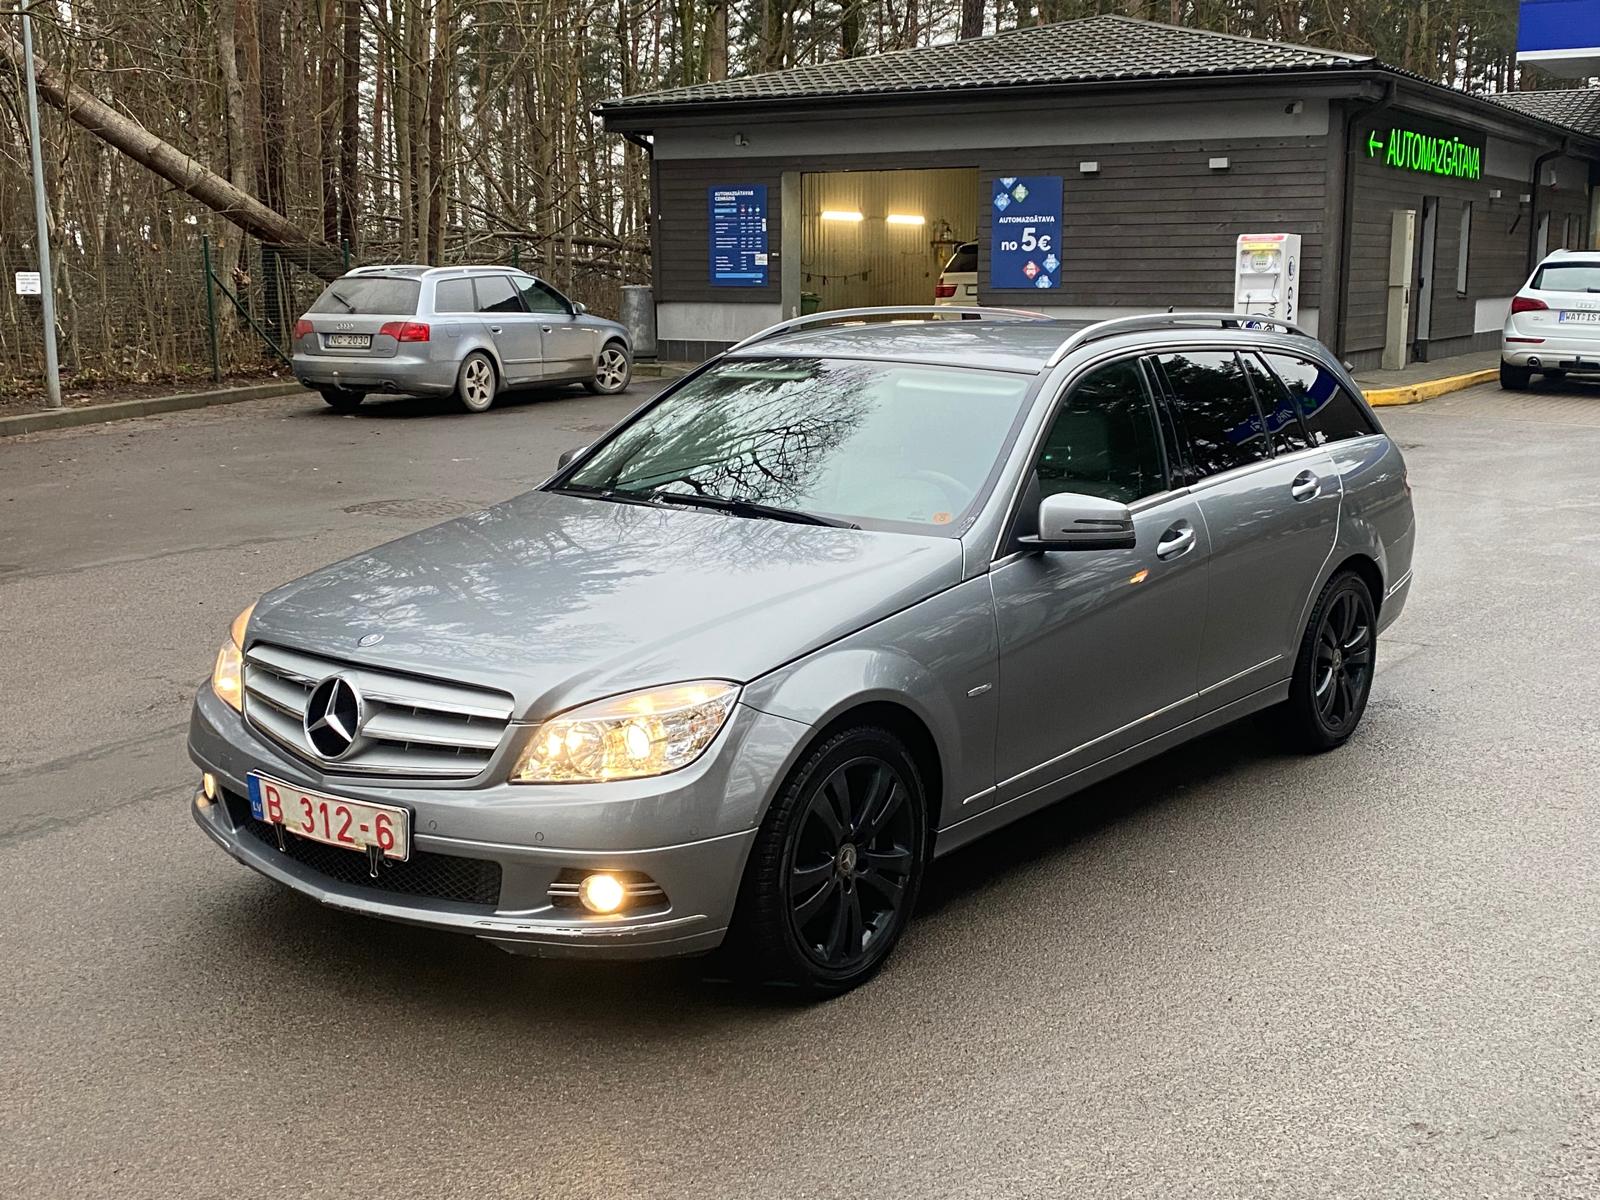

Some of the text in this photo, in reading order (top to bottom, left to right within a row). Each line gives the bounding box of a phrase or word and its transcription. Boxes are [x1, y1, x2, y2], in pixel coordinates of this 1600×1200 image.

[1387, 128, 1480, 180] AUTOMAZGĀTAVA
[998, 215, 1055, 223] AUTOMAZGĀTAVA
[1001, 227, 1052, 252] no 5€
[252, 800, 262, 812] LV
[265, 785, 395, 850] B 312-6
